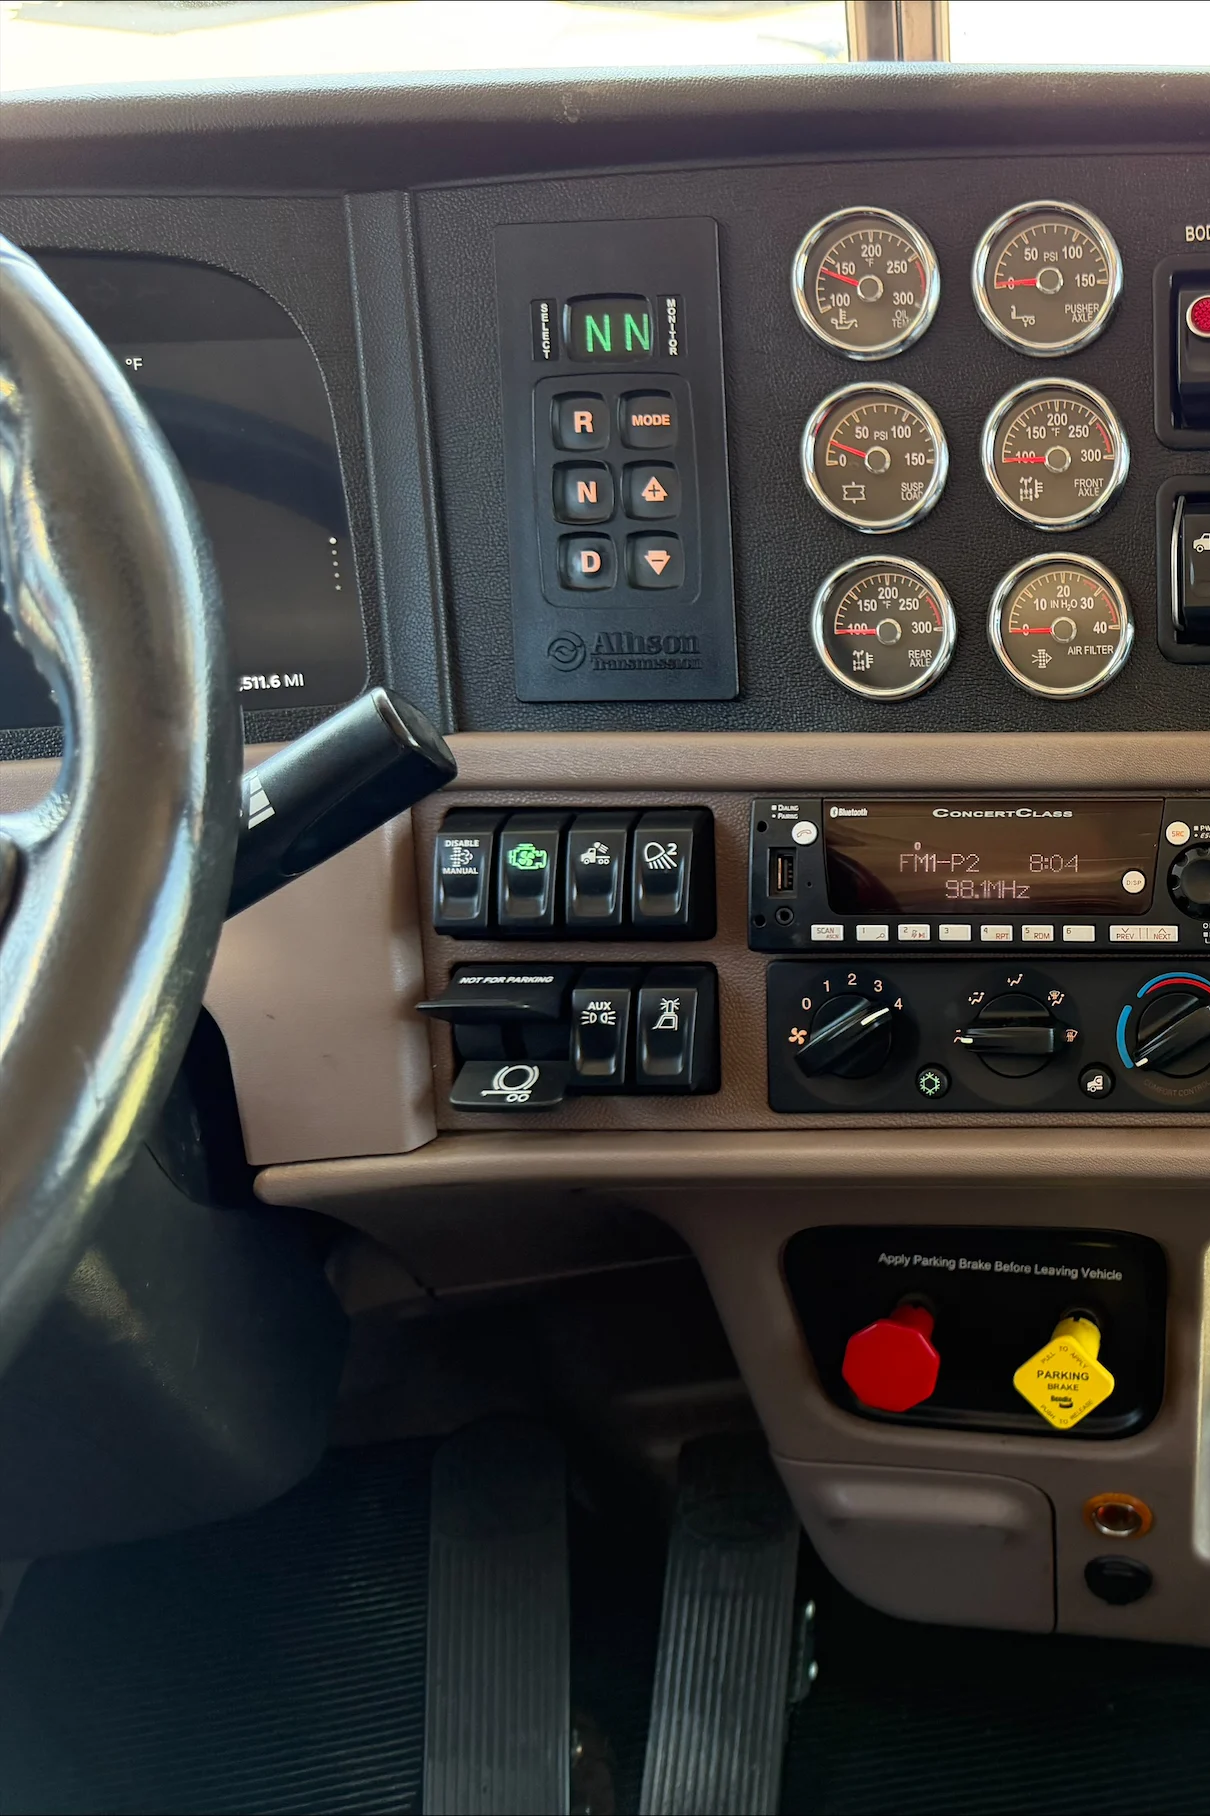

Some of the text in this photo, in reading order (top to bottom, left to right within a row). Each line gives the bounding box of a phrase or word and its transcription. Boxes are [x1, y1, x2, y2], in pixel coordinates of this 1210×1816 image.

[861, 244, 882, 258] 200
[1024, 248, 1038, 261] 50
[1043, 251, 1058, 262] PSI
[1062, 246, 1083, 260] 100
[836, 261, 856, 276] 150
[886, 260, 908, 274] 250
[1074, 274, 1096, 288] 150
[830, 293, 850, 307] 100
[893, 292, 914, 306] 300
[895, 310, 908, 320] OIL
[1065, 304, 1100, 314] PUSHER
[892, 318, 912, 328] TEM
[1071, 312, 1093, 323] AXLE
[540, 303, 550, 359] SELECT
[586, 313, 650, 352] N N
[666, 298, 678, 356] MONITOR
[573, 411, 594, 434] R
[631, 414, 671, 426] MODE
[1047, 413, 1068, 426] 200
[855, 426, 869, 440] 50
[874, 431, 888, 441] PSI
[890, 426, 912, 438] 100
[1026, 426, 1046, 440] 150
[1068, 425, 1090, 438] 250
[839, 454, 847, 468] 0
[904, 453, 925, 466] 150
[1080, 449, 1102, 462] 300
[901, 482, 924, 492] SUSP
[1074, 478, 1104, 488] FRONT
[577, 481, 598, 503] N
[1078, 487, 1100, 497] AXLE
[580, 550, 601, 572] D
[878, 587, 898, 600] 200
[1056, 585, 1070, 598] 20
[857, 600, 878, 612] 150
[898, 598, 920, 610] 250
[1034, 598, 1047, 611] 10
[1050, 600, 1059, 608] IN
[1080, 596, 1094, 610] 30
[911, 622, 932, 634] 300
[1092, 622, 1108, 634] 40
[908, 650, 932, 658] REAR
[1068, 644, 1114, 656] AIR FILTER
[910, 658, 931, 668] AXLE
[284, 673, 304, 688] MI
[838, 808, 868, 816] Bluetooth
[444, 840, 480, 848] DISABLE
[900, 853, 980, 872] FM1-P2
[1029, 854, 1079, 872] 8:04
[442, 867, 478, 875] MANUAL
[945, 879, 1030, 899] 98.1MHz
[459, 976, 554, 984] NOT FOR PARKING
[823, 980, 830, 992] 1
[848, 973, 857, 986] 2
[874, 980, 883, 992] 3
[588, 1001, 612, 1011] AUX
[801, 998, 812, 1010] 0
[894, 998, 903, 1010] 4
[1144, 1079, 1210, 1096] COMFORT CONTROL
[879, 1252, 1123, 1281] Apply Parking Brake Before Leaving Vehicle
[1041, 1352, 1056, 1364] PULL
[1070, 1352, 1088, 1368] APPLY
[1037, 1370, 1089, 1380] PARKING
[1048, 1383, 1079, 1391] BRAKE
[1041, 1404, 1056, 1420] PUSH
